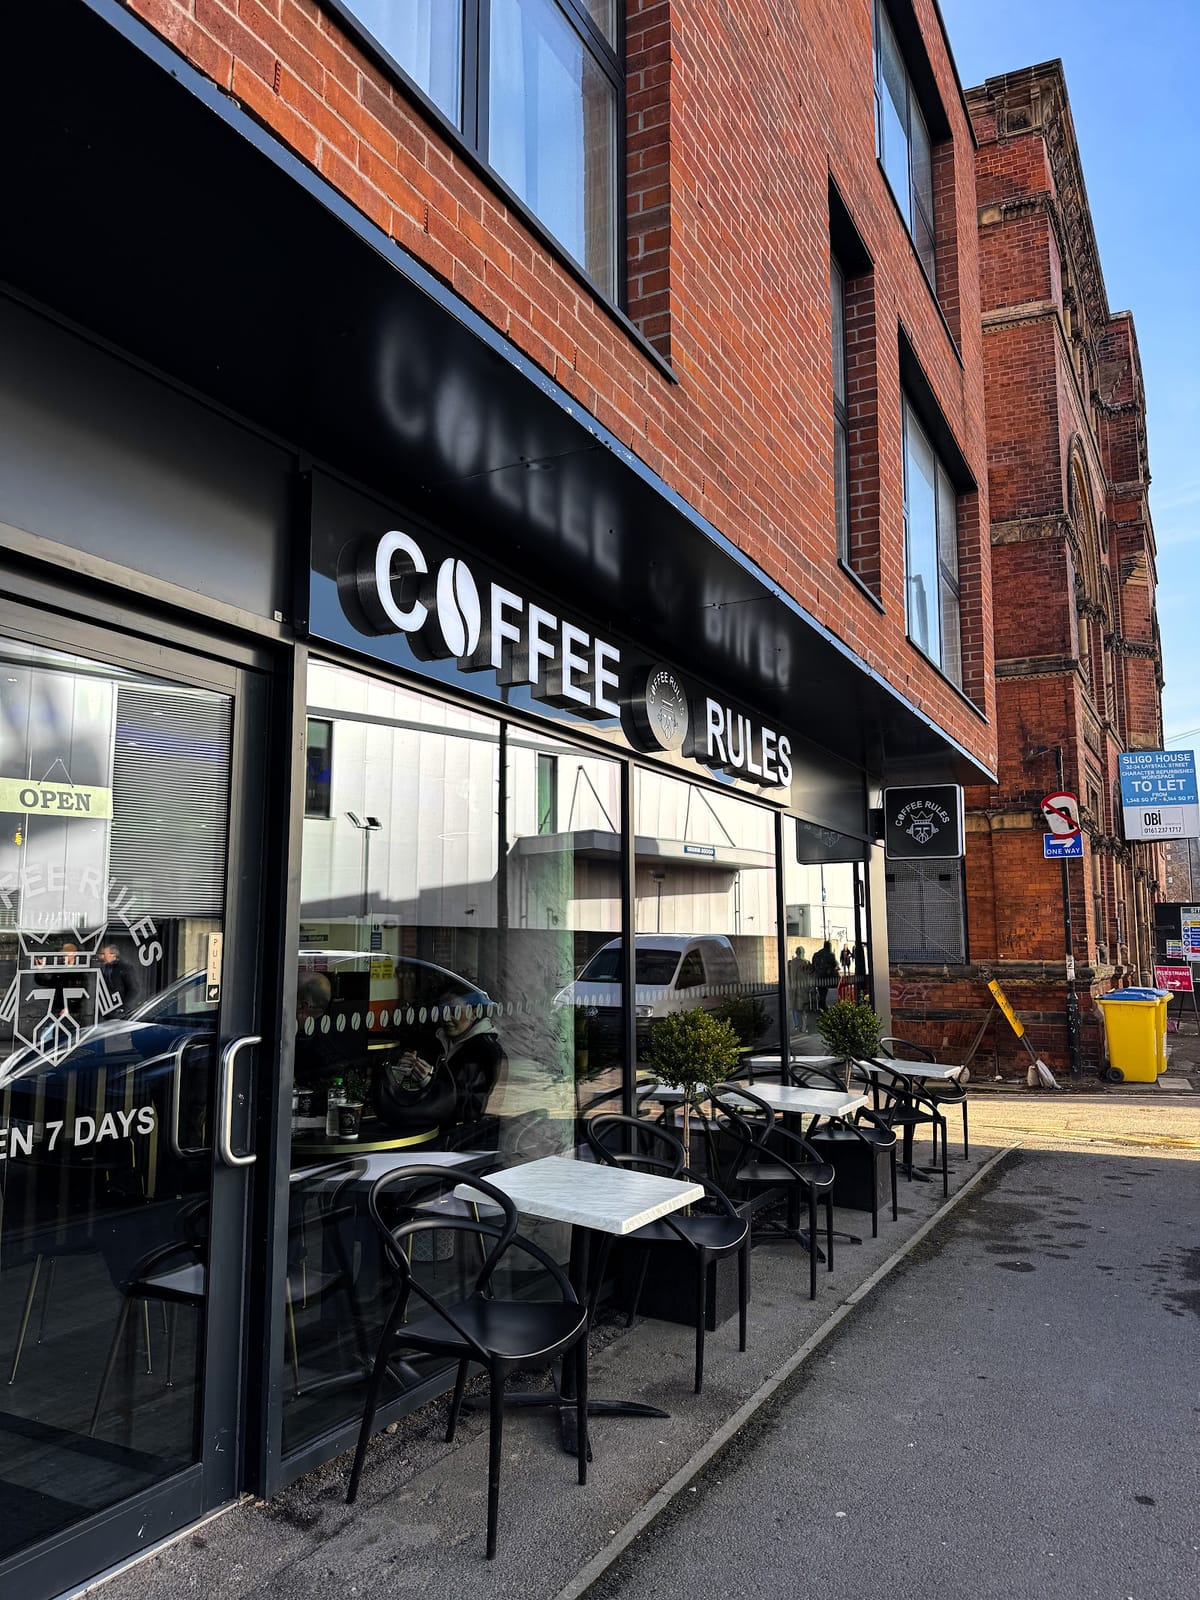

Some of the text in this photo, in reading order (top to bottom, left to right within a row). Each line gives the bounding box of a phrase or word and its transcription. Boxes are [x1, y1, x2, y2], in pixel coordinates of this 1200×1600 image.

[375, 530, 621, 719] COFFEE
[706, 697, 793, 788] RULES
[1123, 753, 1191, 764] SLIGO HOUSE
[1131, 779, 1186, 792] TO LET
[20, 788, 91, 811] OPEN
[895, 800, 950, 826] COFFEE RULES
[79, 867, 163, 967] RULES
[46, 1120, 63, 1151] 7
[74, 1106, 155, 1147] DAYS
